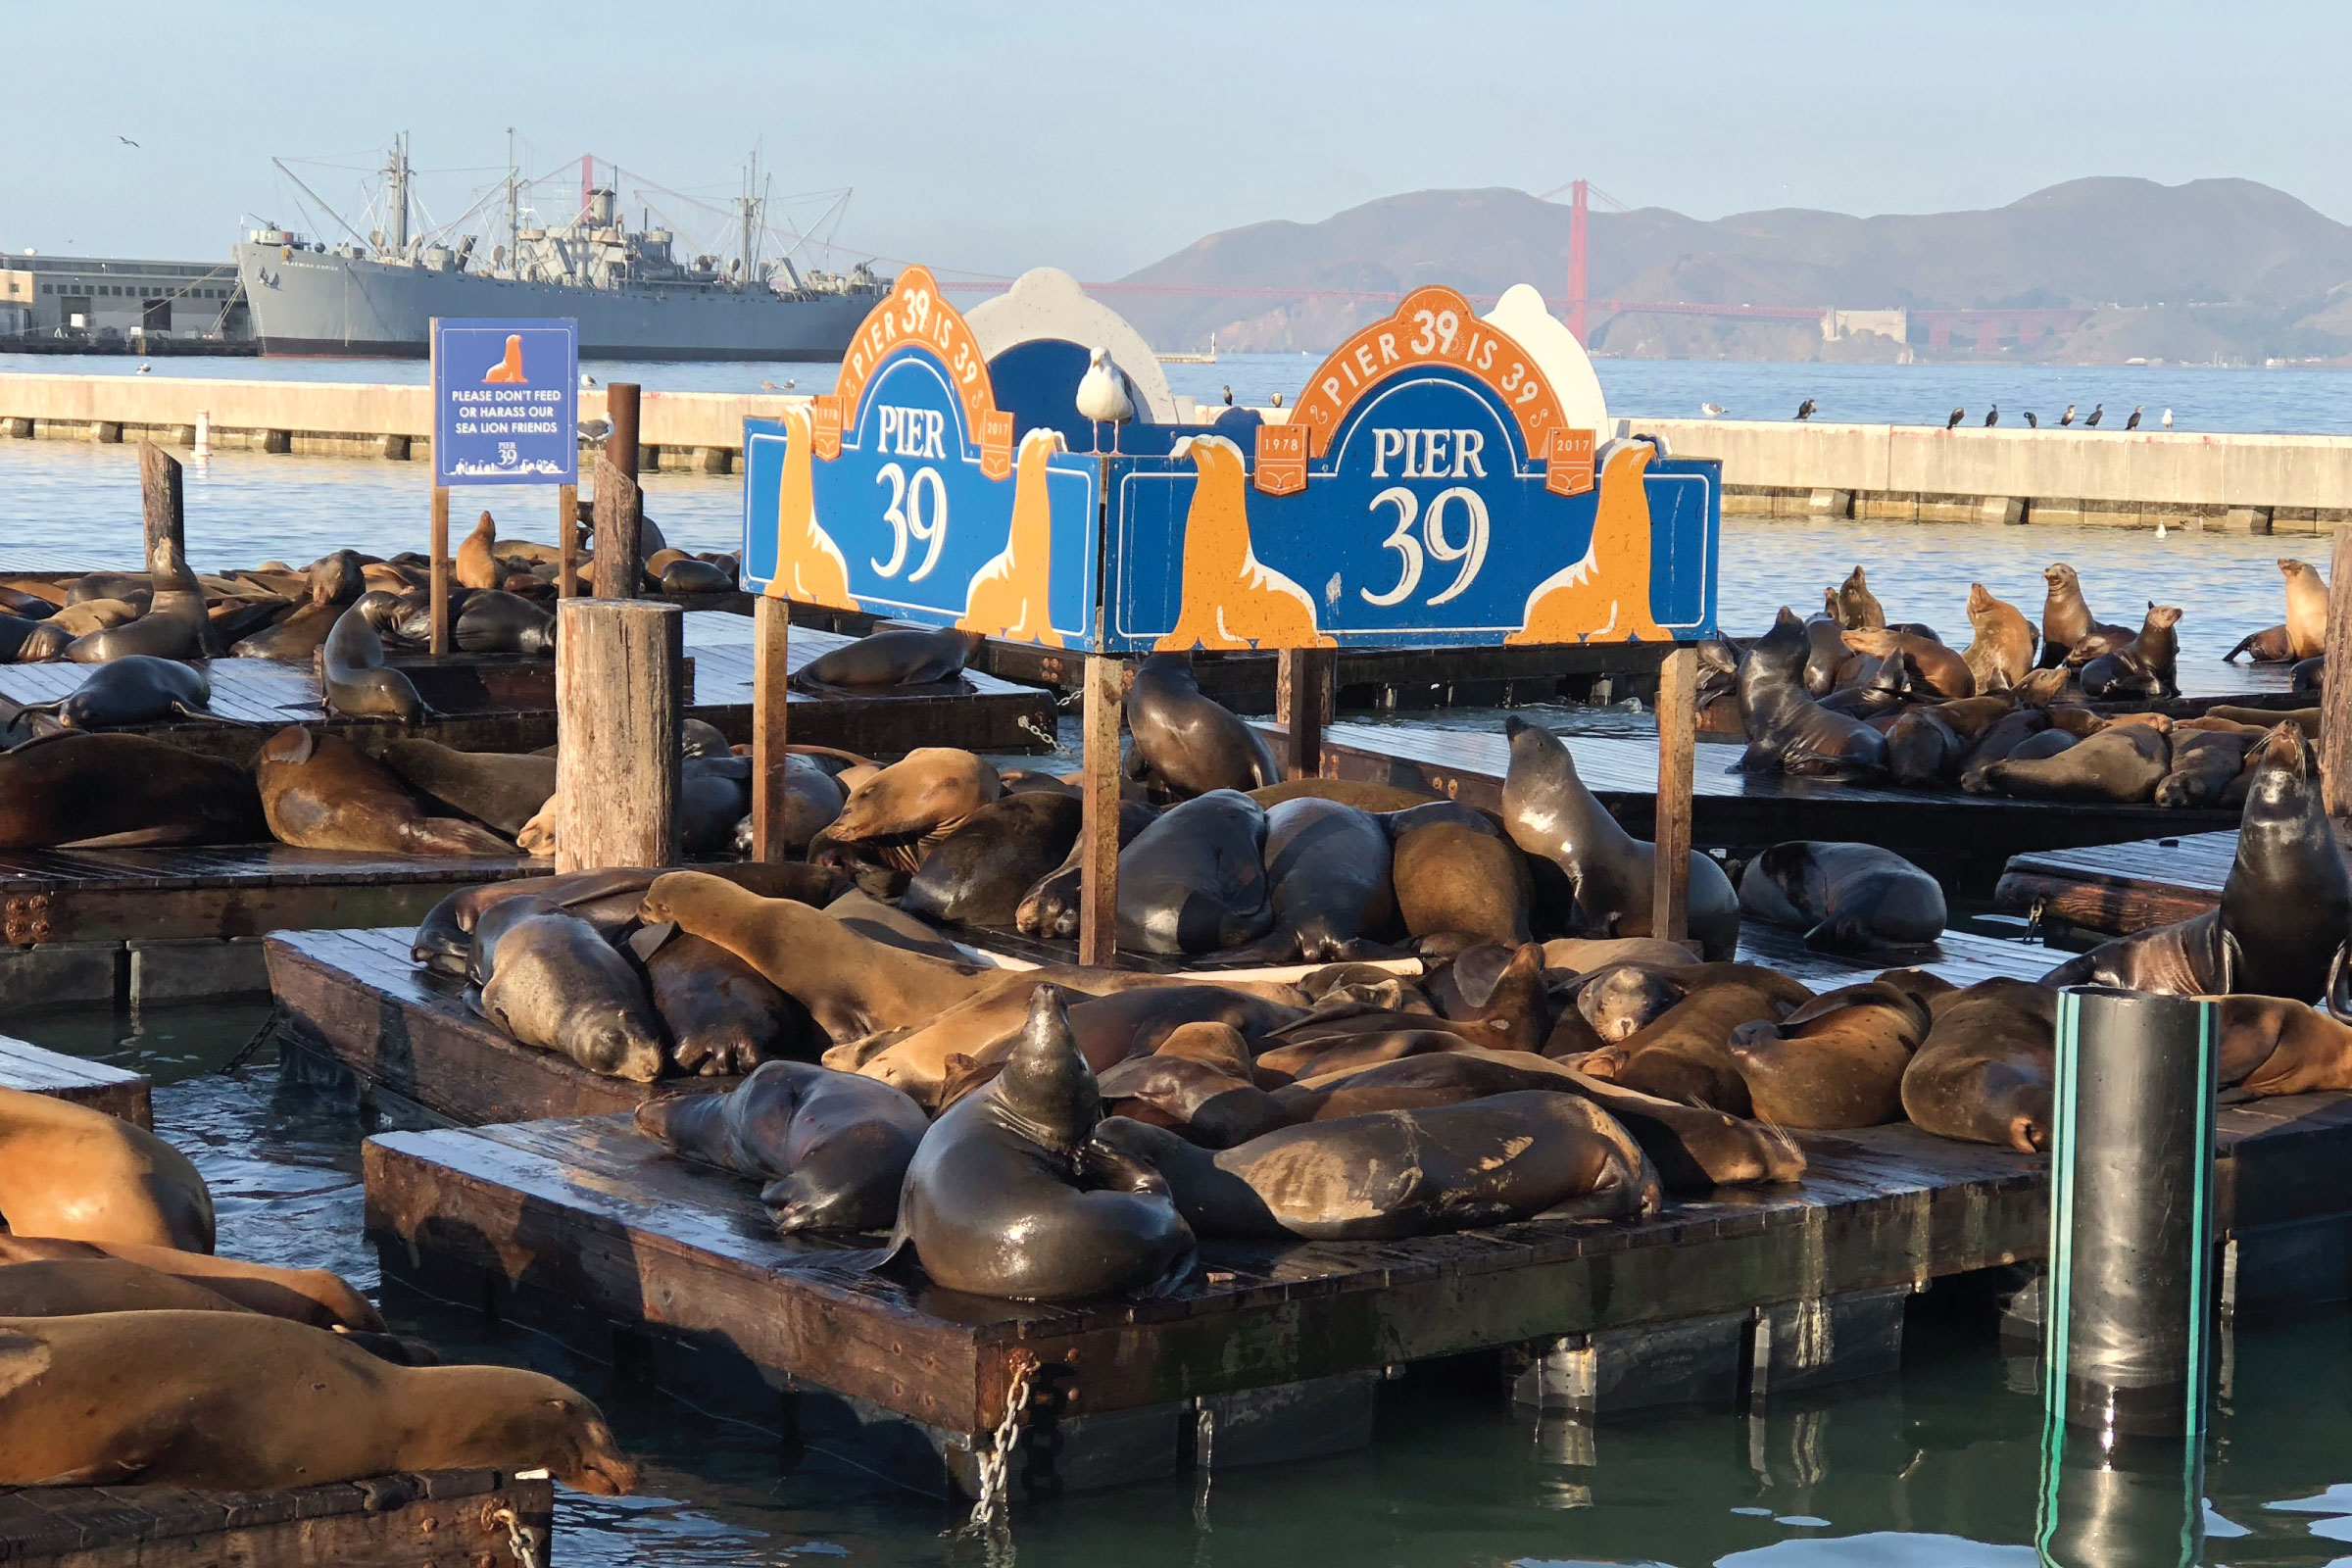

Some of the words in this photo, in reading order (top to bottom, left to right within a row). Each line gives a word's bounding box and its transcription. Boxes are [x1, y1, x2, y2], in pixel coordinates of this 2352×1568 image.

[852, 311, 897, 381] PIER
[902, 288, 930, 333] 39
[933, 311, 953, 349] IS
[954, 341, 977, 384] 39
[1321, 332, 1400, 407] PIER
[1410, 309, 1459, 356] 39
[1466, 332, 1497, 370] IS
[1501, 363, 1539, 404] 39
[452, 390, 492, 402] PLEASE
[495, 389, 531, 402] DON'T
[534, 389, 562, 401] FEED
[459, 406, 477, 418] OR
[479, 406, 526, 417] HARASS
[528, 406, 554, 417] OUR
[455, 422, 477, 434] SEA
[480, 422, 509, 433] LION
[512, 421, 558, 433] FRIENDS
[877, 405, 947, 460] PIER
[987, 421, 1008, 436] 2017
[498, 441, 516, 450] PIER
[1265, 438, 1298, 451] 1978
[1370, 427, 1489, 478] PIER
[1556, 439, 1590, 452] 2017
[497, 449, 517, 466] 39
[870, 462, 948, 583] 39
[1359, 486, 1491, 607] 39
